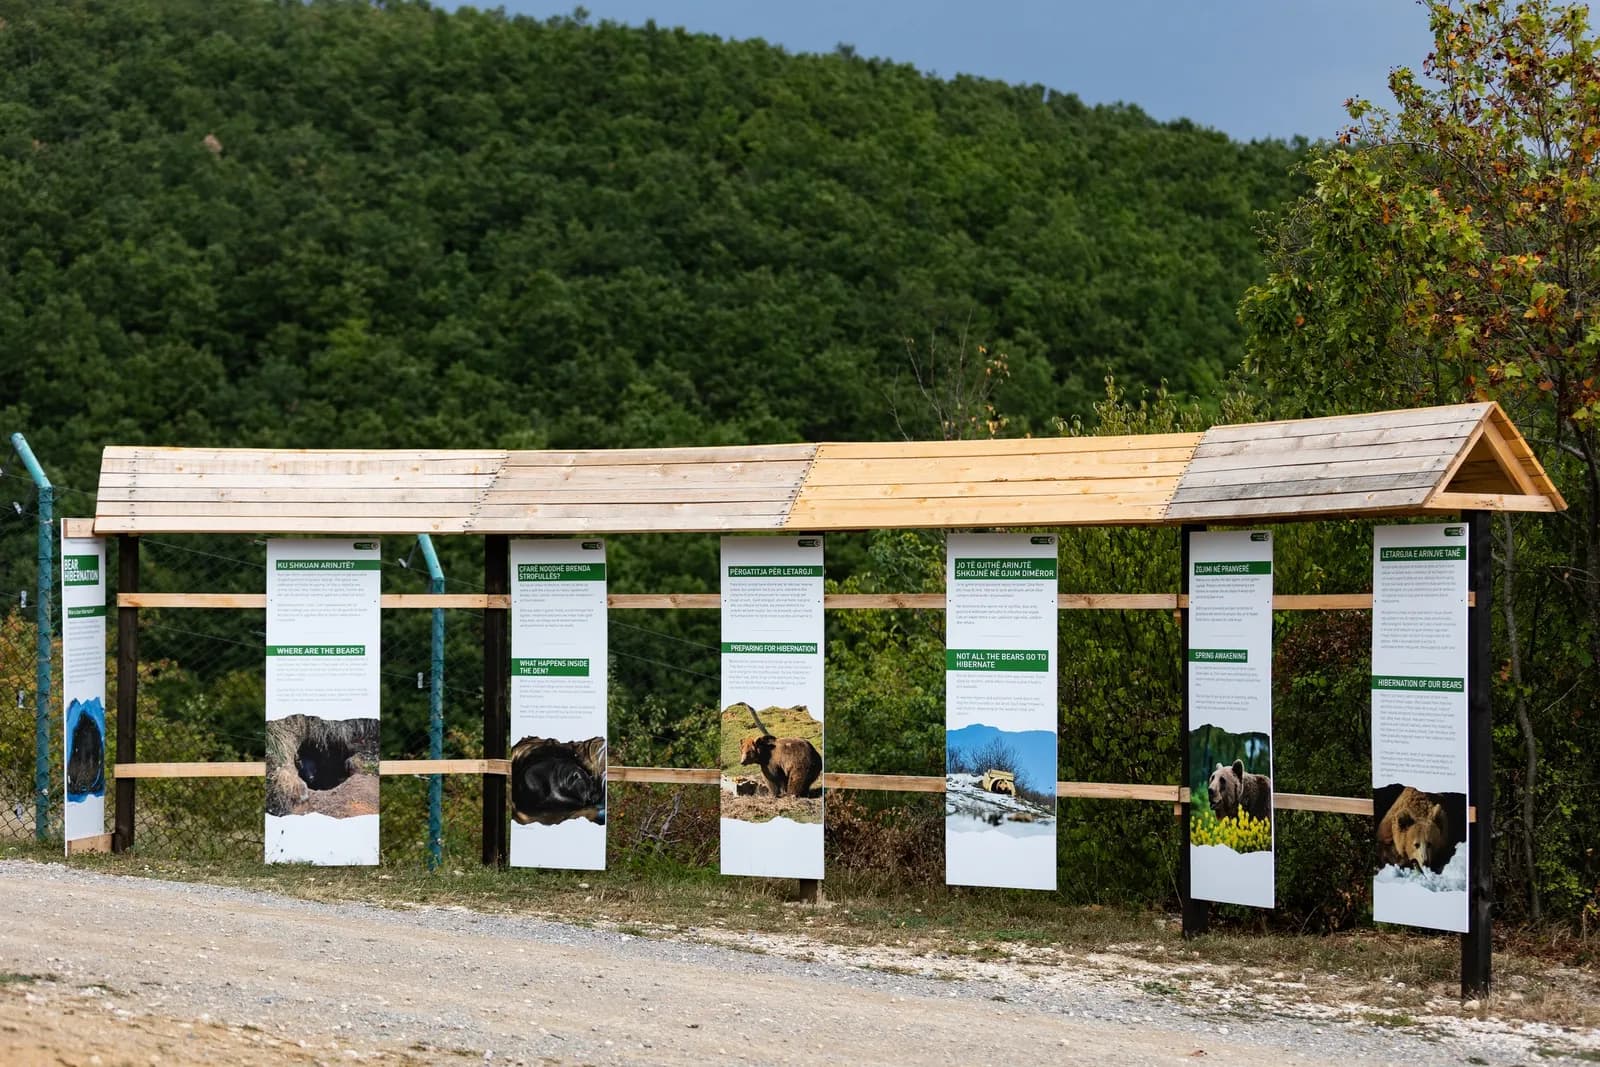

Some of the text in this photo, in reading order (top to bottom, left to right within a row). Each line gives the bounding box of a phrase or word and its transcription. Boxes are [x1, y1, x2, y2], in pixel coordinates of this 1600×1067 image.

[1378, 680, 1418, 688] HIBERNATION
[1428, 680, 1441, 688] OUR
[1442, 680, 1462, 689] BEARS
